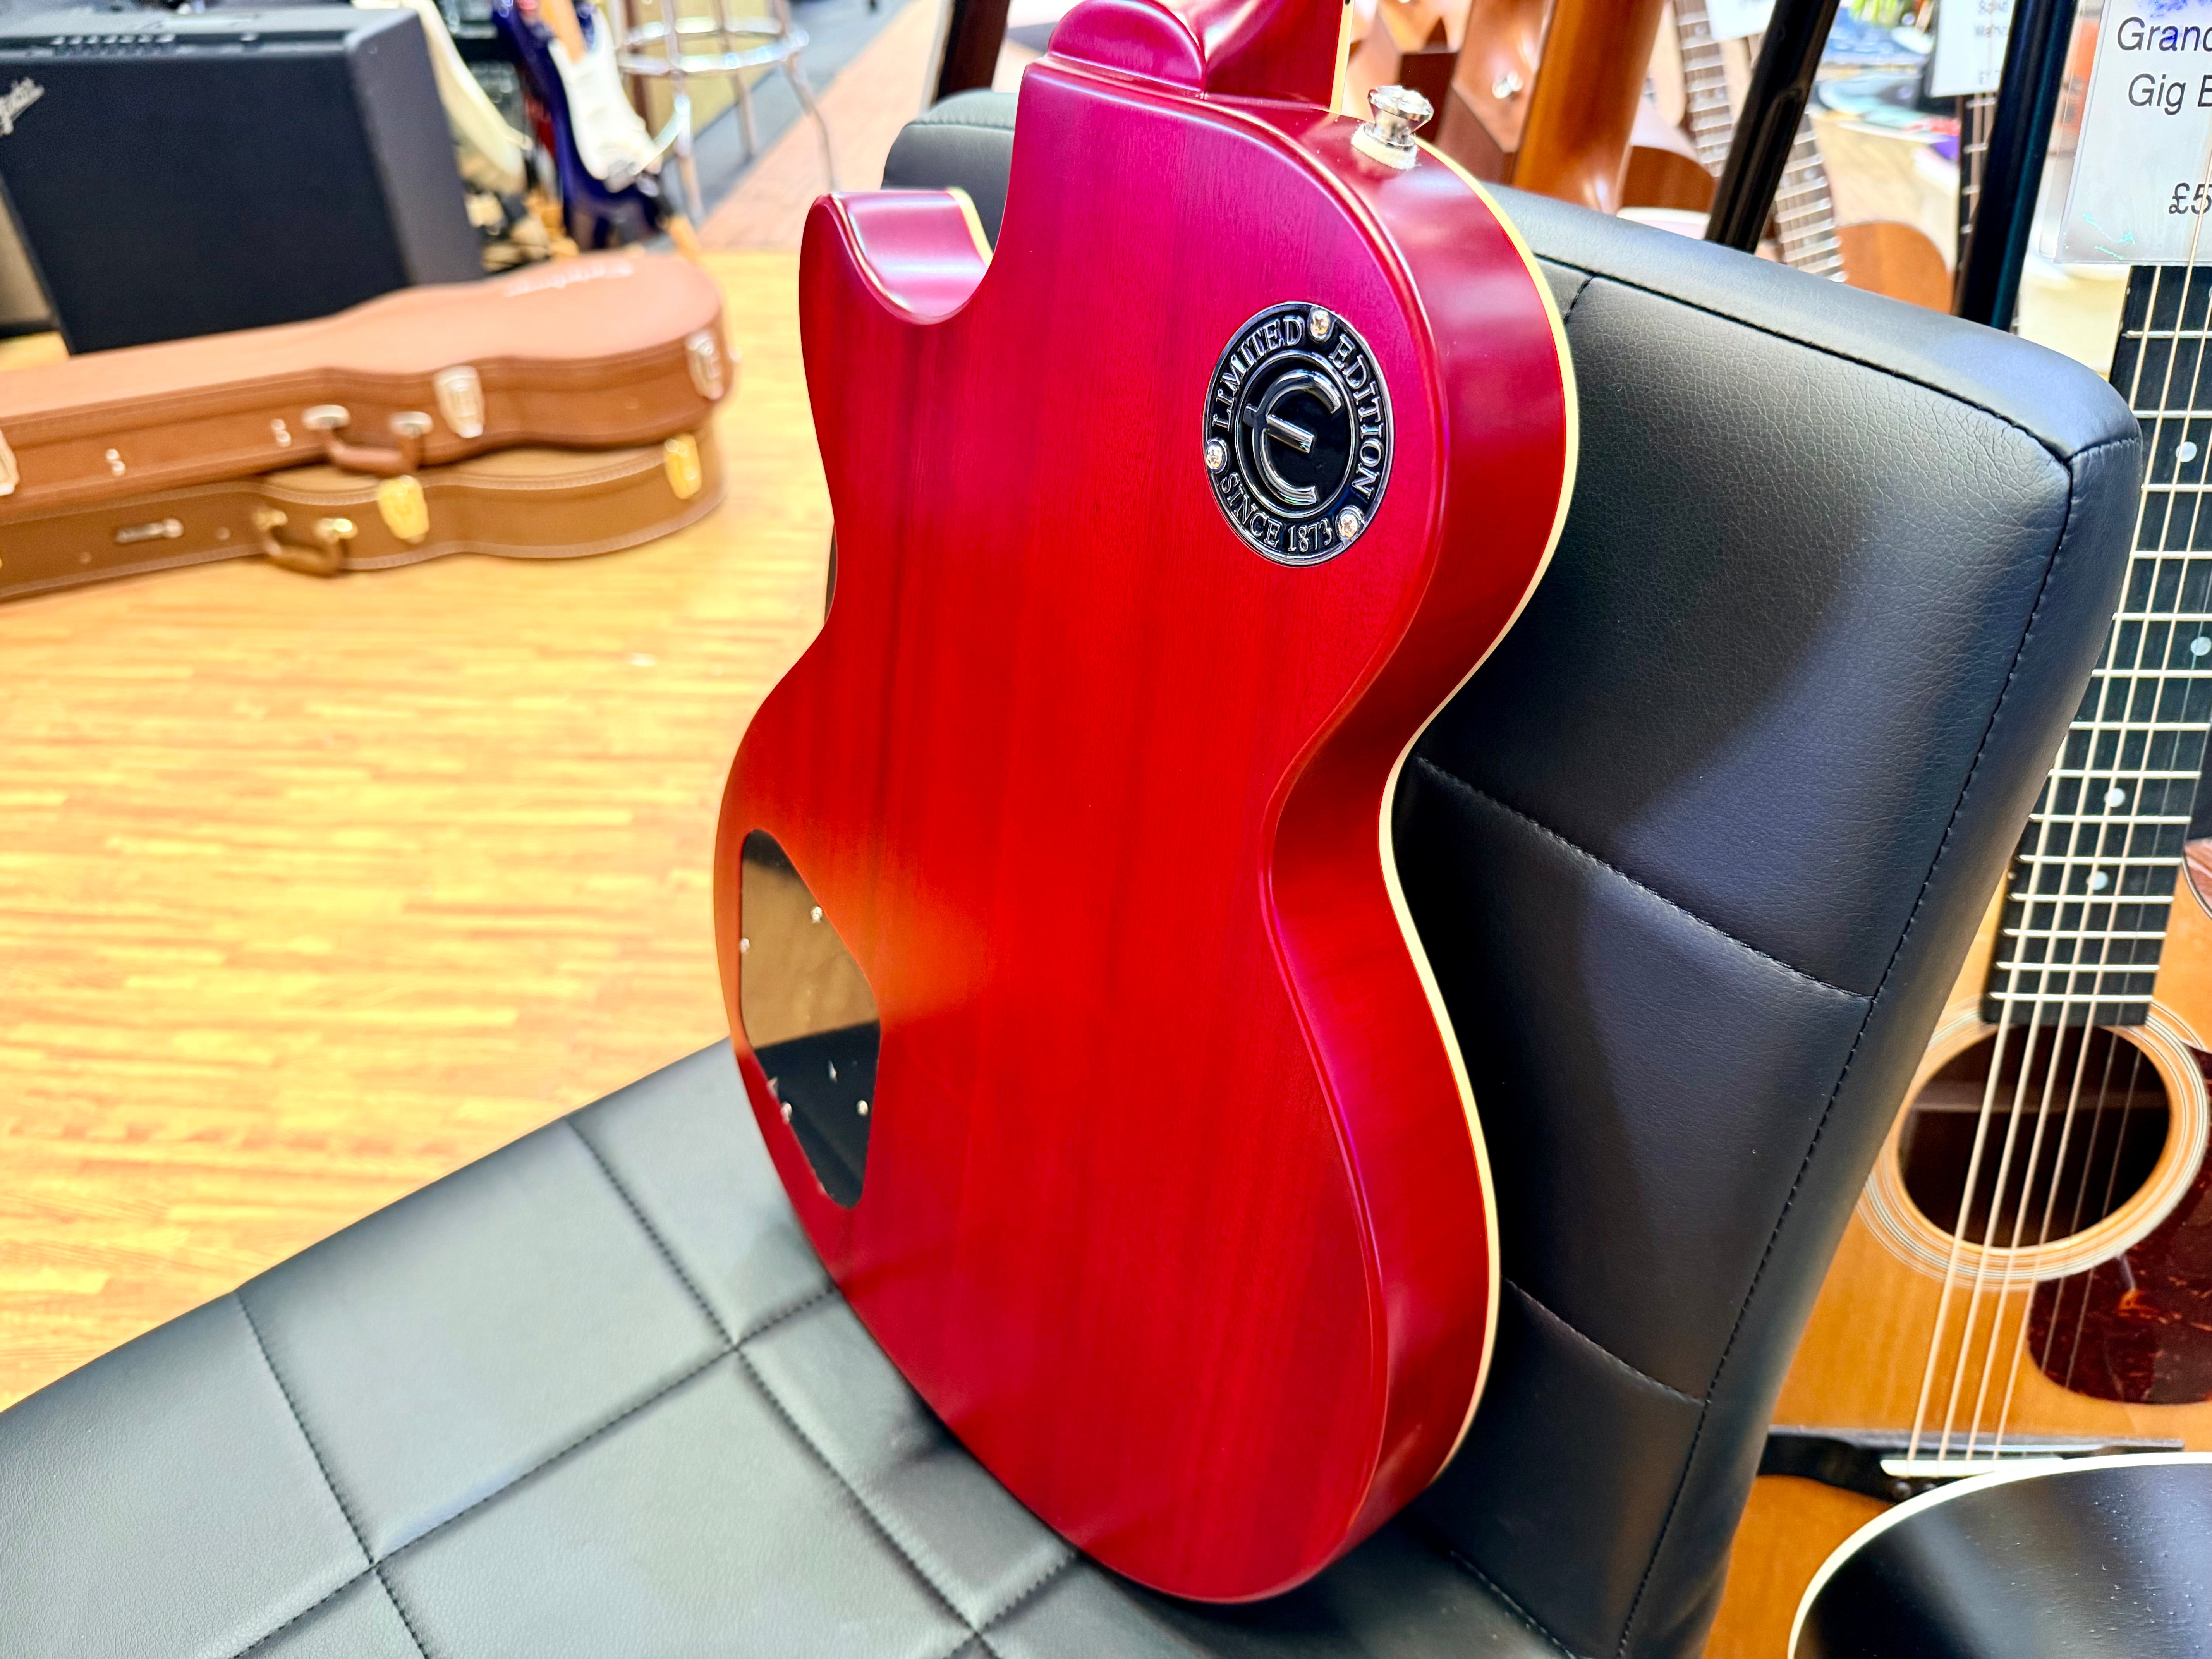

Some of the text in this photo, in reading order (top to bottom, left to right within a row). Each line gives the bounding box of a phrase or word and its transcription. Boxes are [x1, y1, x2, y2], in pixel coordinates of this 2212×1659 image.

[2128, 73, 2187, 116] Gig
[1212, 315, 1385, 499] LIMITED EDITION
[1220, 472, 1333, 553] SINCE 1873
